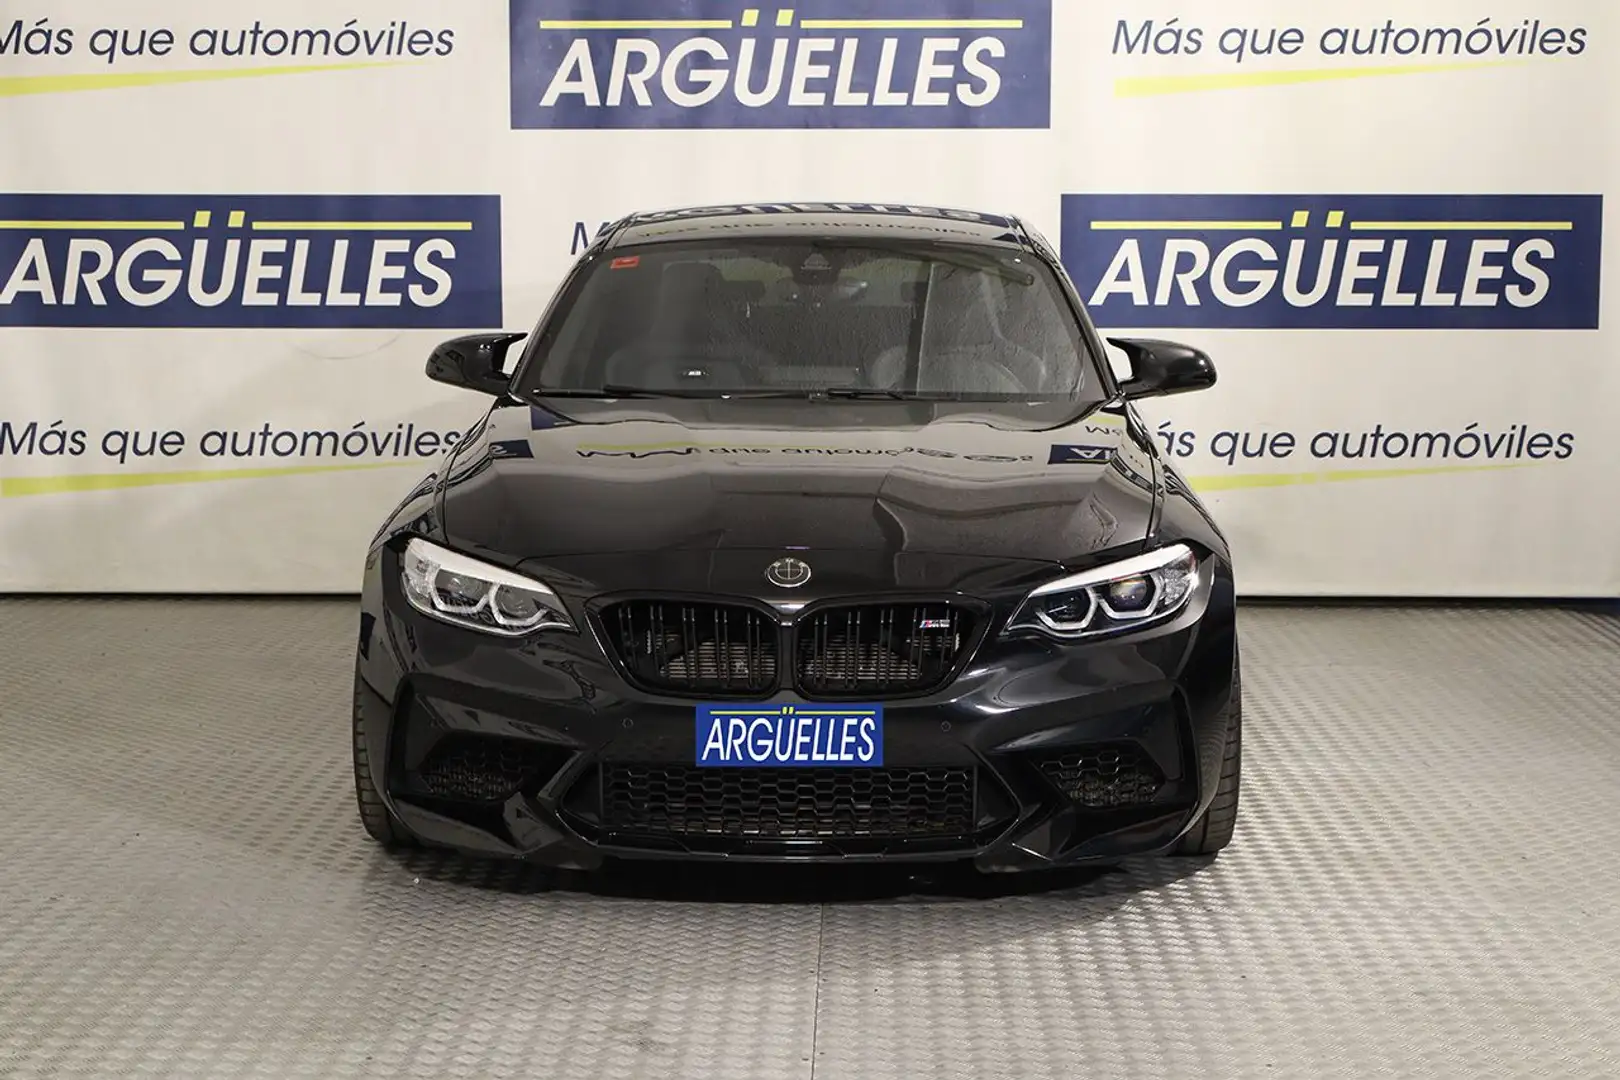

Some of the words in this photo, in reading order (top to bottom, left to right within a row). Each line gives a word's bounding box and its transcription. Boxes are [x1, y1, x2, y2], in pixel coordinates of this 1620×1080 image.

[0, 18, 74, 56] Más
[89, 29, 174, 63] que
[189, 19, 454, 56] automóviles
[540, 9, 1005, 107] ARGÜELLES
[1112, 18, 1203, 55] Más
[1219, 28, 1304, 62] que
[1320, 18, 1587, 55] automóviles
[0, 211, 456, 307] ARGÜELLES
[1088, 210, 1555, 308] ARGÜELLES
[0, 420, 87, 456] Más
[101, 431, 185, 464] que
[199, 421, 461, 457] automóviles
[1157, 421, 1196, 457] ás
[1210, 431, 1296, 465] que
[1309, 423, 1575, 459] automóviles
[702, 707, 876, 762] ARGÜELLES
